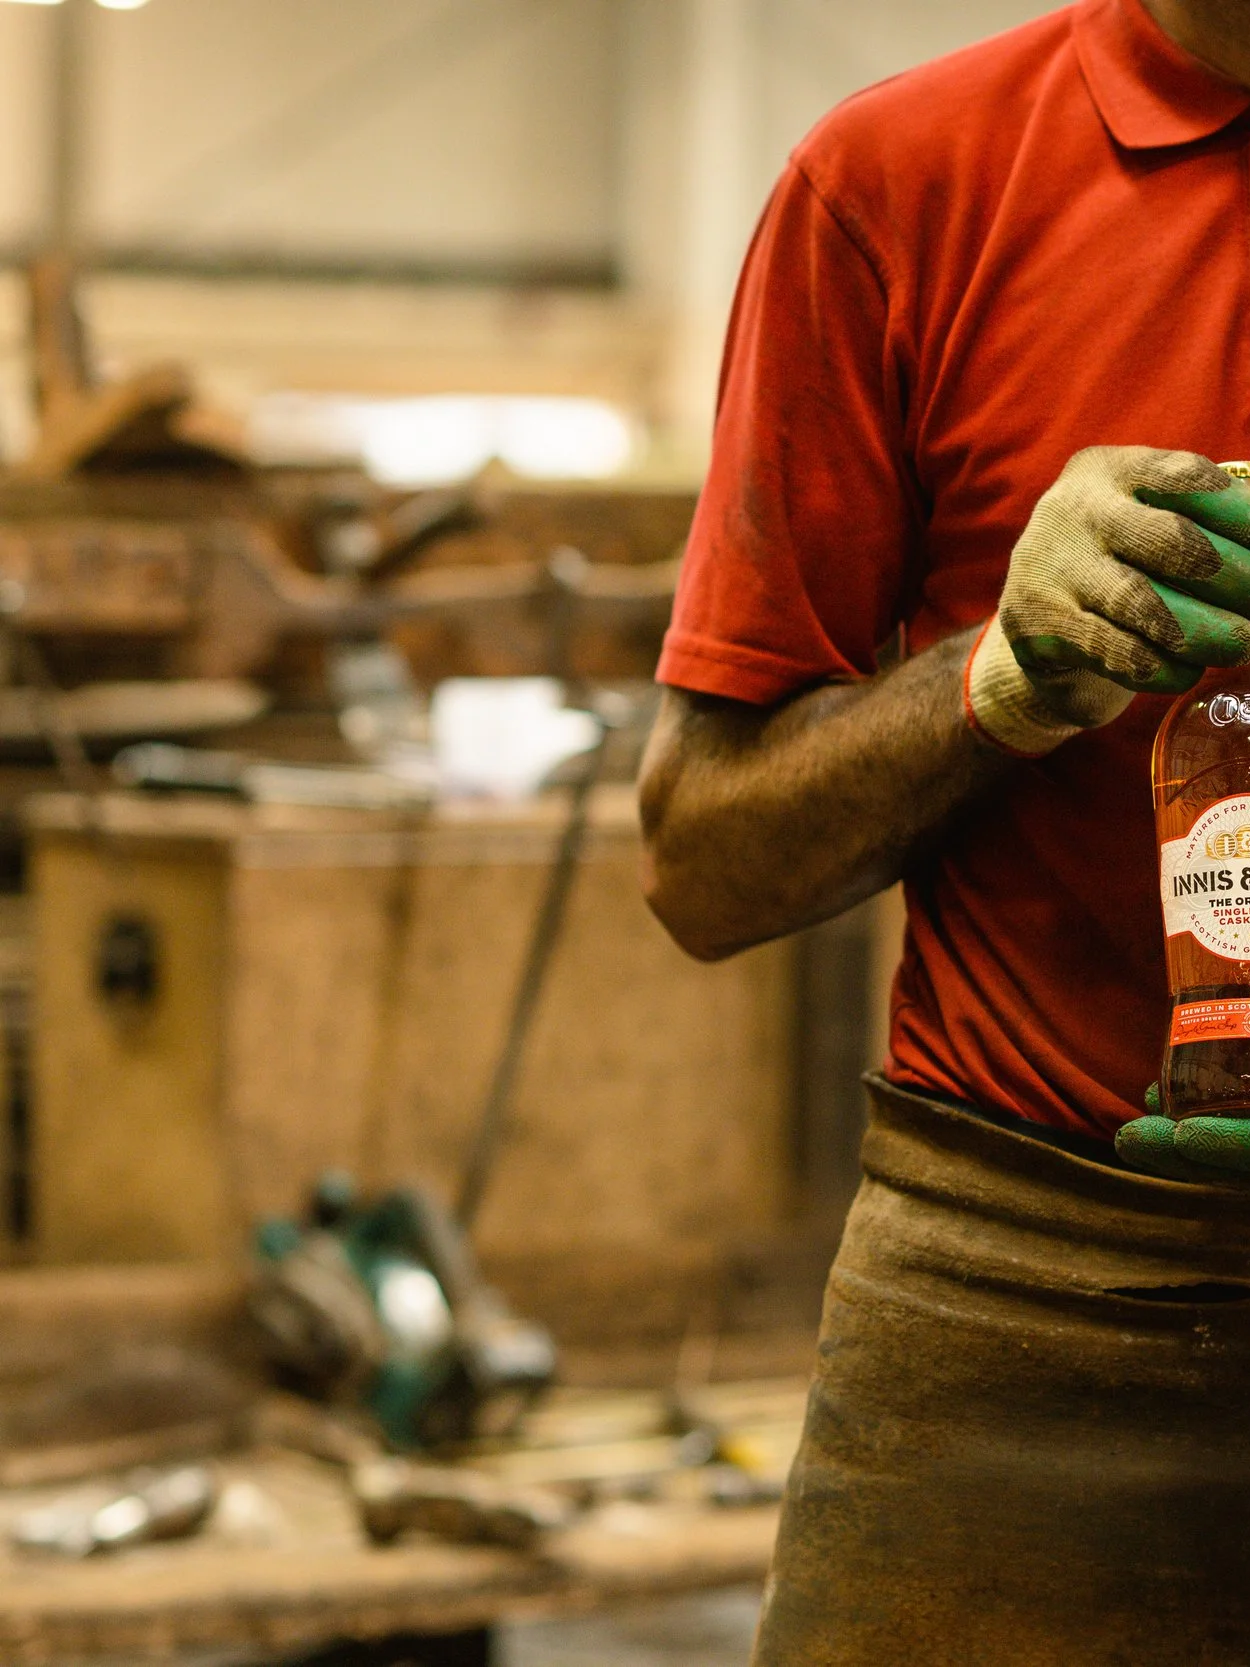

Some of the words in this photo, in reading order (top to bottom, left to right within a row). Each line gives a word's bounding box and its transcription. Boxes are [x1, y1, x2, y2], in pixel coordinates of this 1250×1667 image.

[1186, 812, 1221, 860] MATURED
[1223, 803, 1246, 814] FOR
[1173, 869, 1234, 897] INNIS
[1209, 898, 1232, 908] THE
[1219, 917, 1250, 926] CASK
[1191, 914, 1237, 952] SCOTTISH
[1181, 1006, 1212, 1016] BREWED
